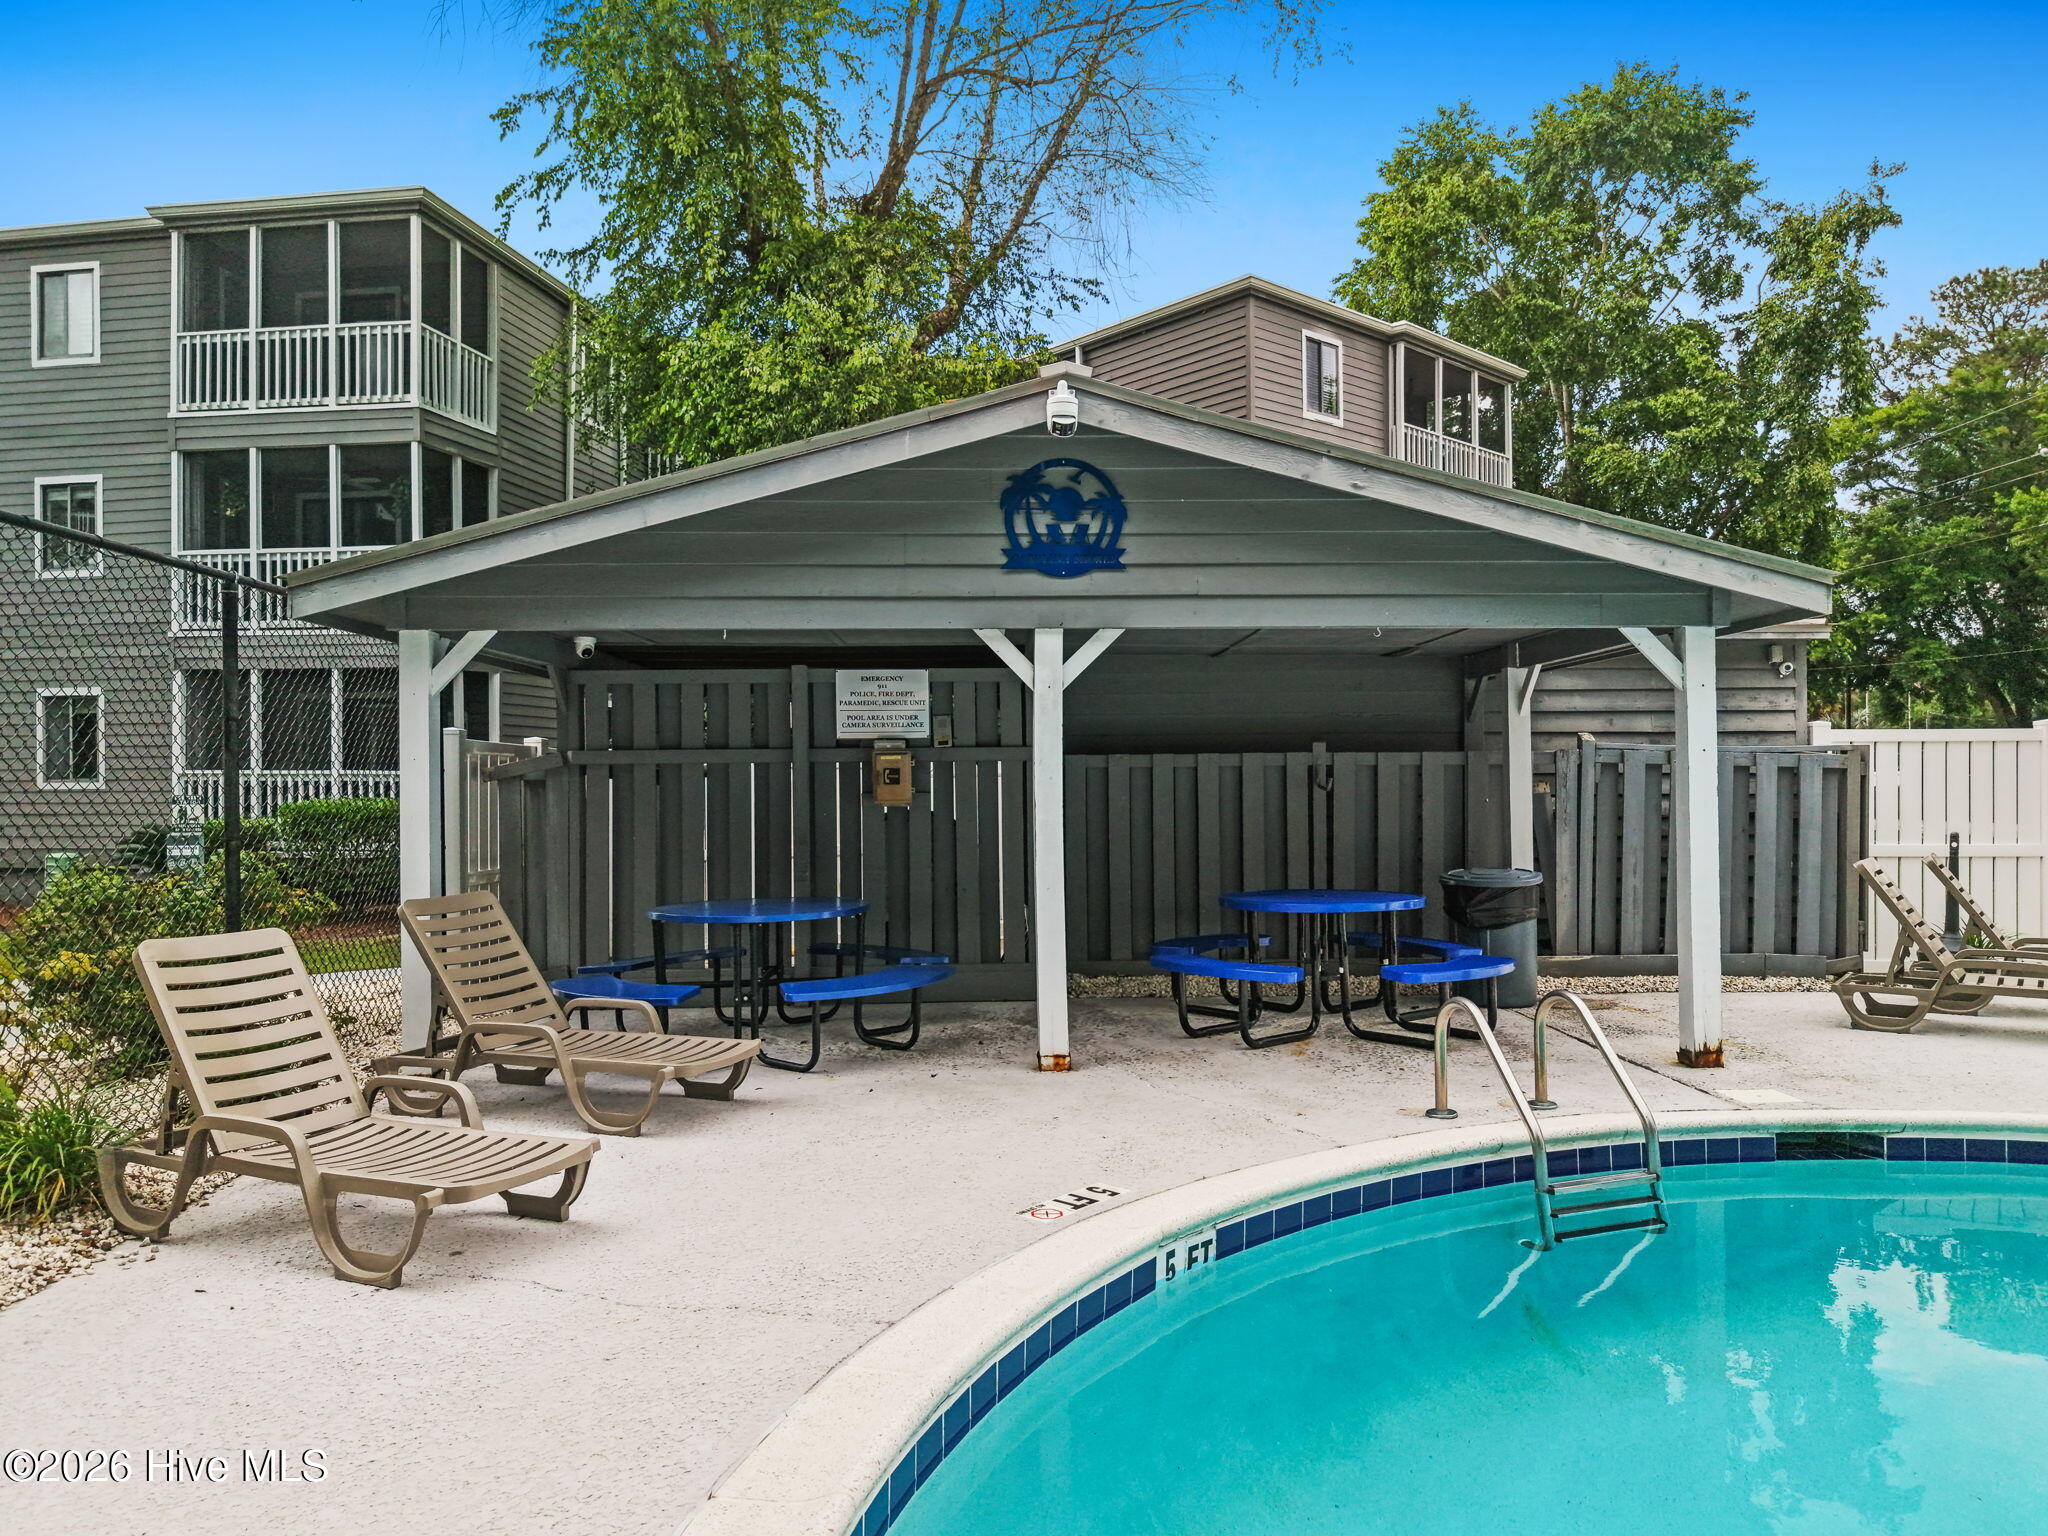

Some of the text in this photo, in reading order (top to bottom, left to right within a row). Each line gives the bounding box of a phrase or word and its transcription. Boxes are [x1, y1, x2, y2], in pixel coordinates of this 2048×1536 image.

[1086, 1186, 1121, 1197] 5
[1053, 1193, 1100, 1211] FT
[1165, 1238, 1213, 1282] 5 FT
